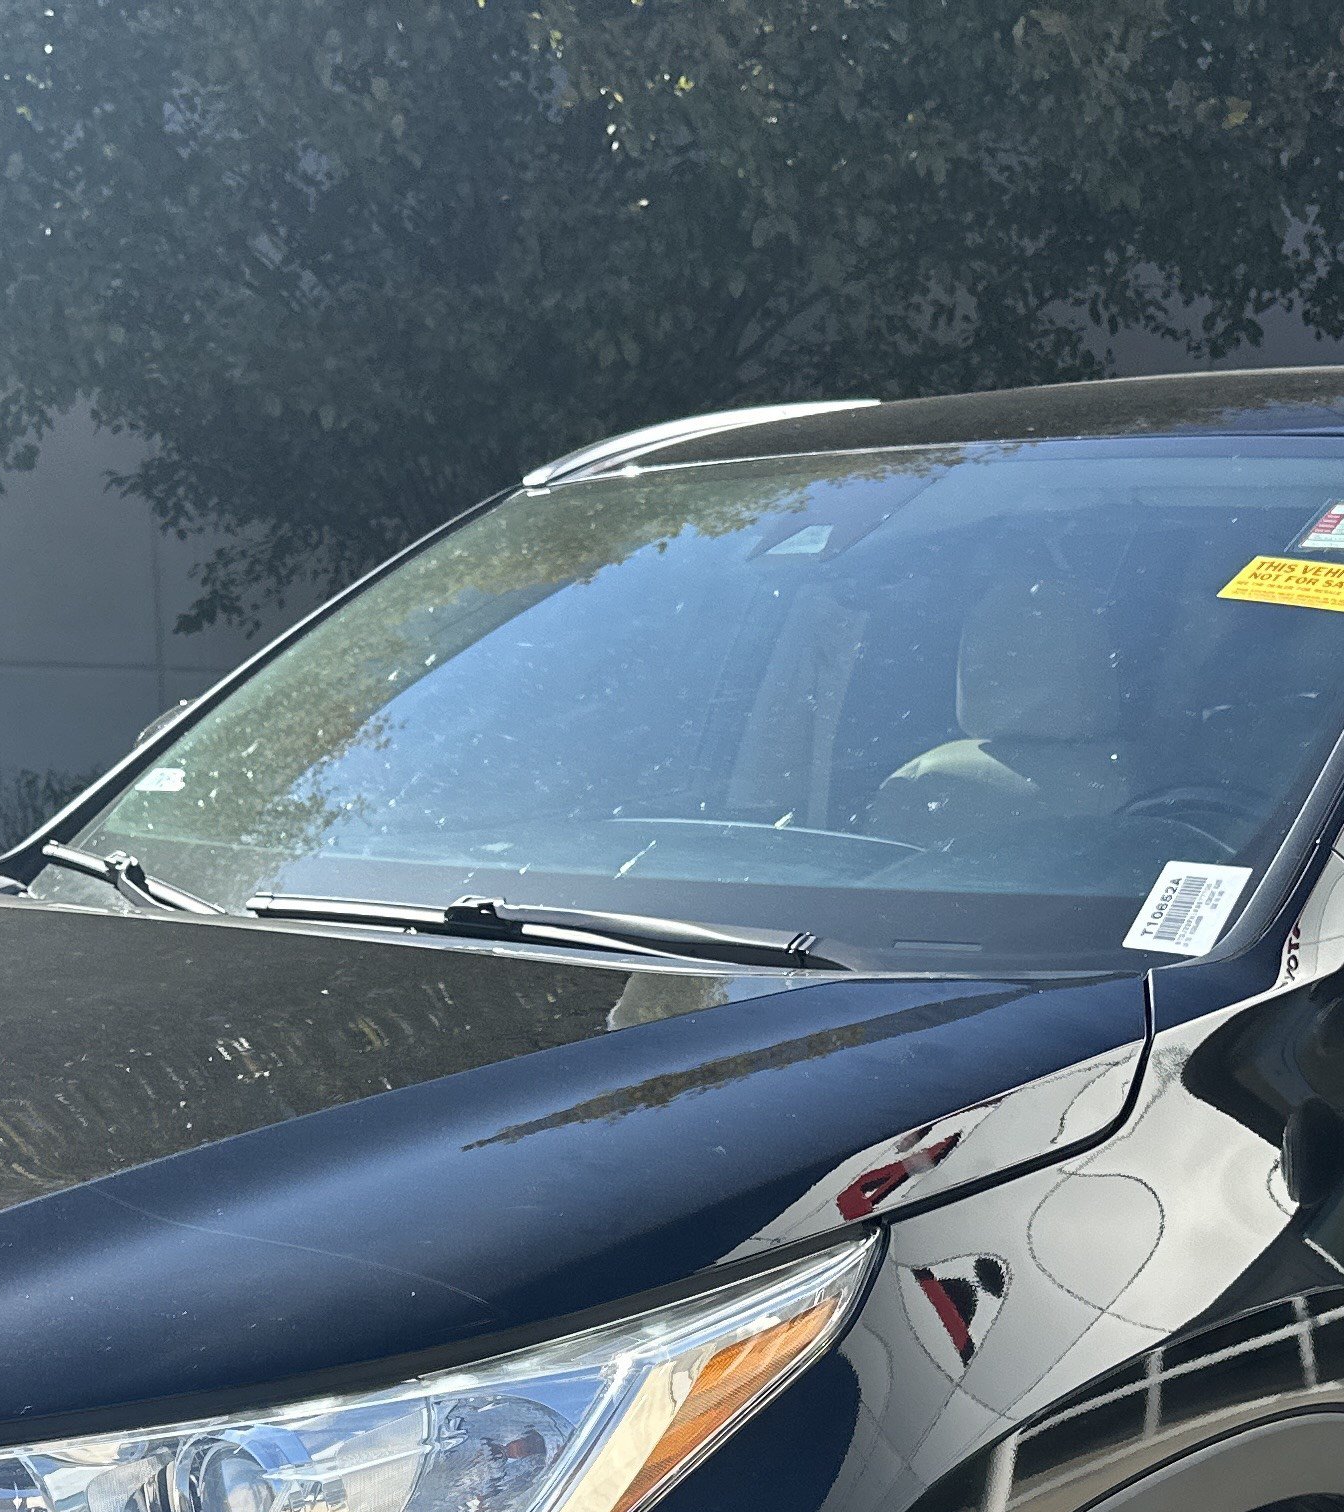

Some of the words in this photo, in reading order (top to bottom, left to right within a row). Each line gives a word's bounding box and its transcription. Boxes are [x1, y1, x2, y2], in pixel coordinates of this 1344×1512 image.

[1256, 561, 1298, 573] THIS
[1248, 572, 1282, 582] NOT
[1284, 575, 1319, 586] FOR
